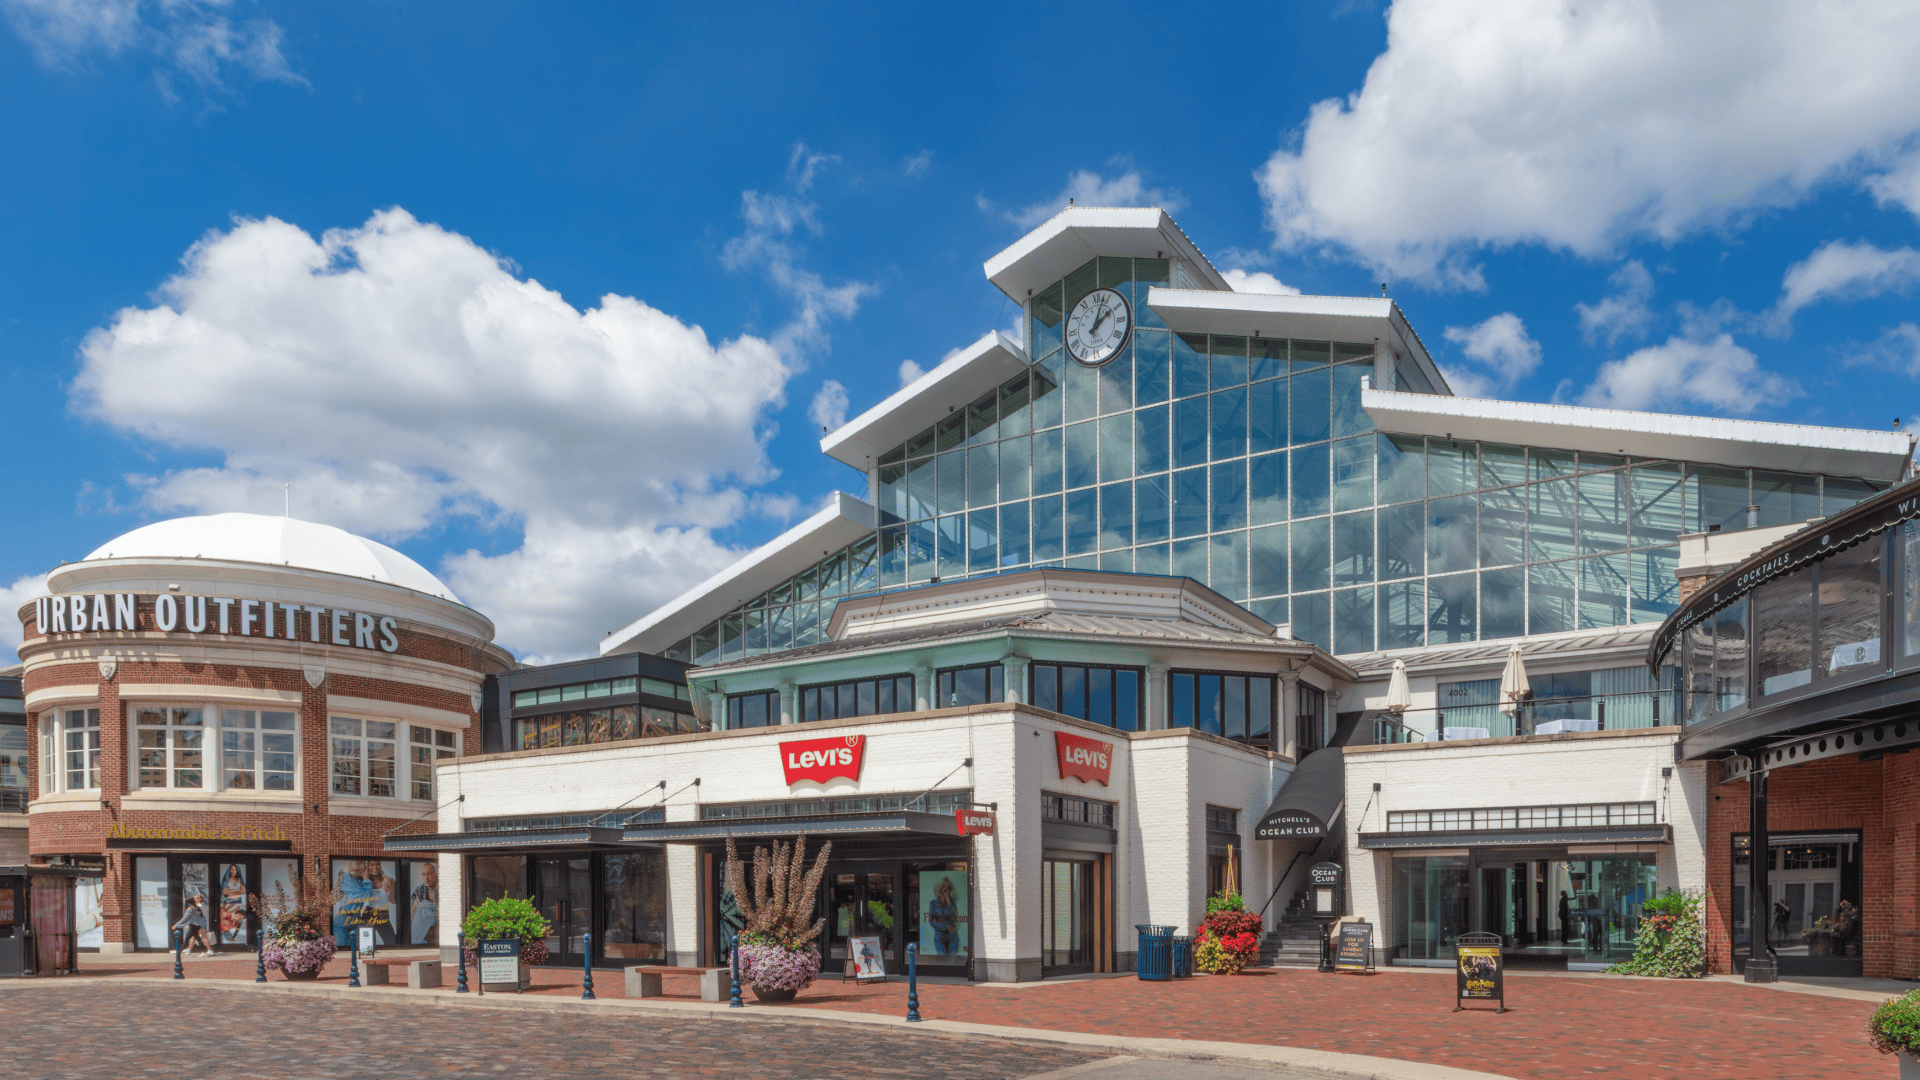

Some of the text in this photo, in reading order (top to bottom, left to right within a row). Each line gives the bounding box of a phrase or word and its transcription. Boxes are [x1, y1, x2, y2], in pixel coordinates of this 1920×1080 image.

[1737, 553, 1789, 587] COCKTAILS
[36, 593, 400, 653] URBAN OUTFITTERS
[1448, 688, 1468, 697] 4002
[1269, 817, 1310, 825] MITCHELL'S
[108, 822, 286, 841] Abercrombie & Fitch
[1260, 826, 1321, 836] OCEAN CLUB
